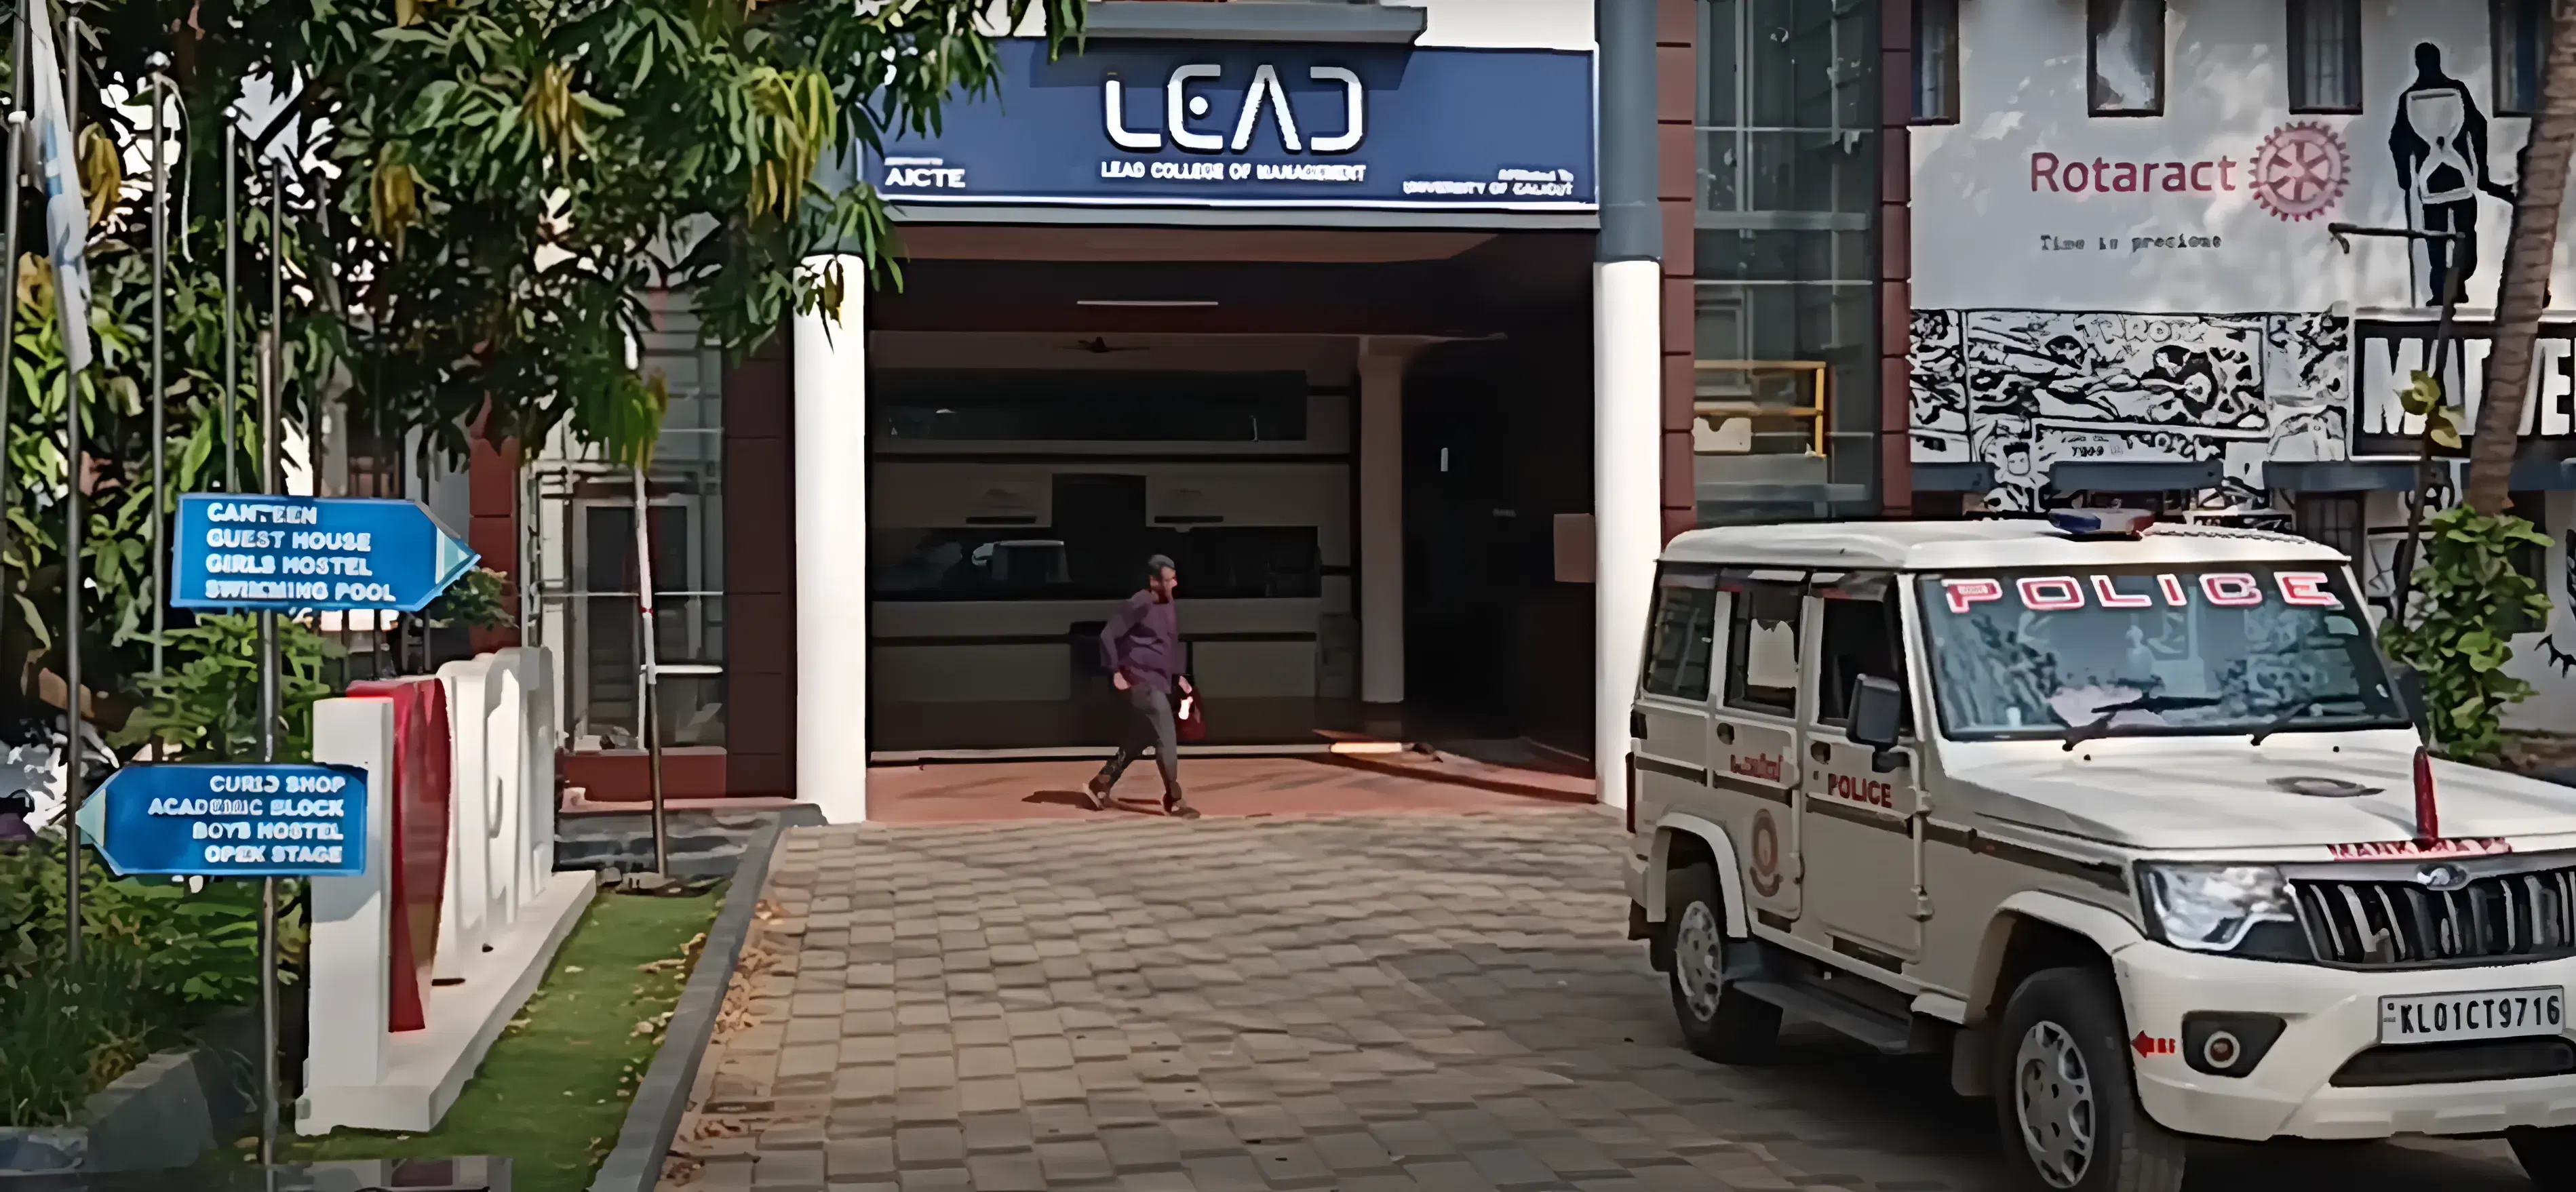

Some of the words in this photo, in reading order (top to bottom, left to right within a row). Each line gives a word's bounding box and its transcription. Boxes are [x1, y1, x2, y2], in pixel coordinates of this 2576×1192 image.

[1106, 64, 1363, 151] LEAD
[884, 167, 966, 188] AICTE
[1101, 161, 1146, 178] LEAD
[1152, 162, 1224, 180] COLLEGE
[1229, 163, 1251, 179] OF
[2031, 153, 2237, 193] Rotaract
[207, 528, 284, 549] GUEST
[292, 532, 371, 552] HOUSE
[206, 553, 275, 574] GIRLS
[282, 557, 372, 576] HOSTEL
[334, 583, 395, 602] POOL
[1940, 571, 2341, 613] POLICE
[286, 776, 346, 793] SHOP
[1828, 773, 1892, 808] POLICE
[270, 799, 344, 816] BLOCK
[193, 822, 251, 839] BOYS
[257, 822, 344, 840] HOSTEL
[271, 846, 343, 863] STAGE
[2400, 995, 2560, 1033] KL01CT9716
